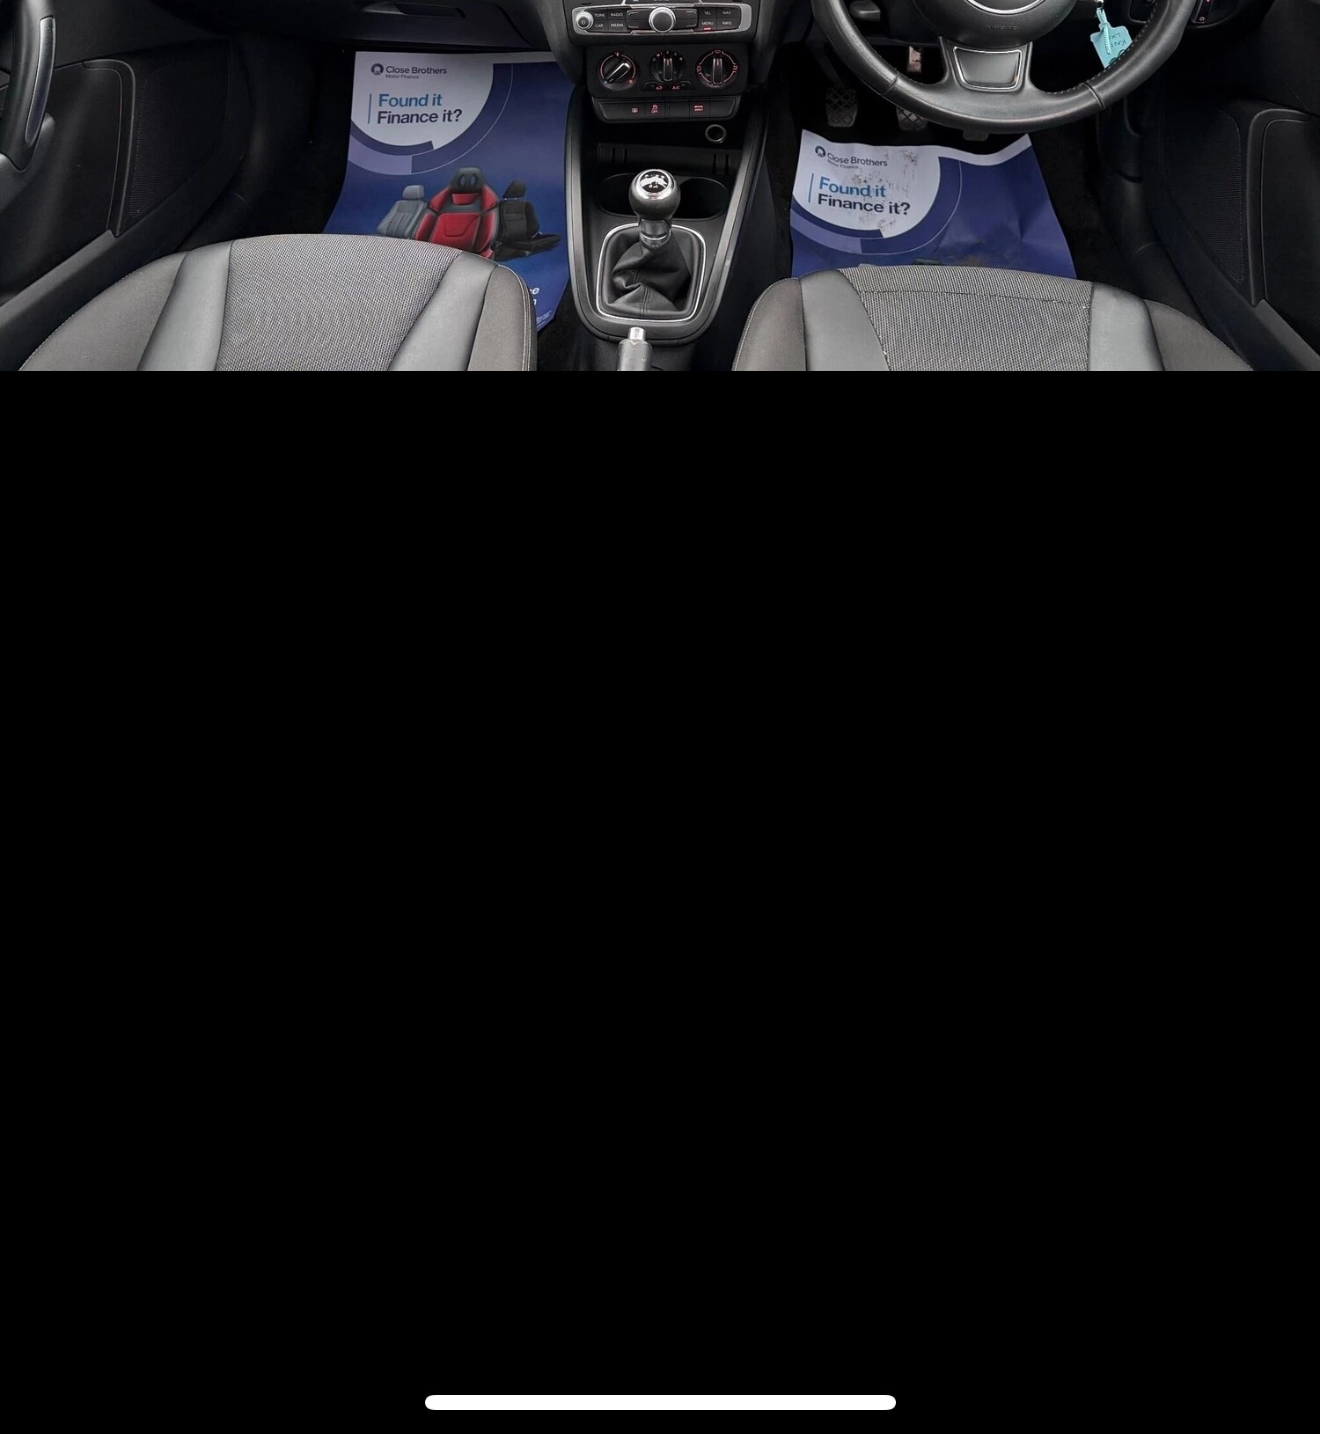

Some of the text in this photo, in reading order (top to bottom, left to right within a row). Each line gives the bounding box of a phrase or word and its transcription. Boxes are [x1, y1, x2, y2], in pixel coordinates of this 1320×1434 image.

[385, 65, 447, 75] Close Brothers
[378, 93, 443, 107] Found it
[377, 108, 462, 124] Finance it?
[827, 152, 888, 167] Close Brothers
[819, 176, 887, 197] Found it
[818, 193, 911, 215] Finance it?
